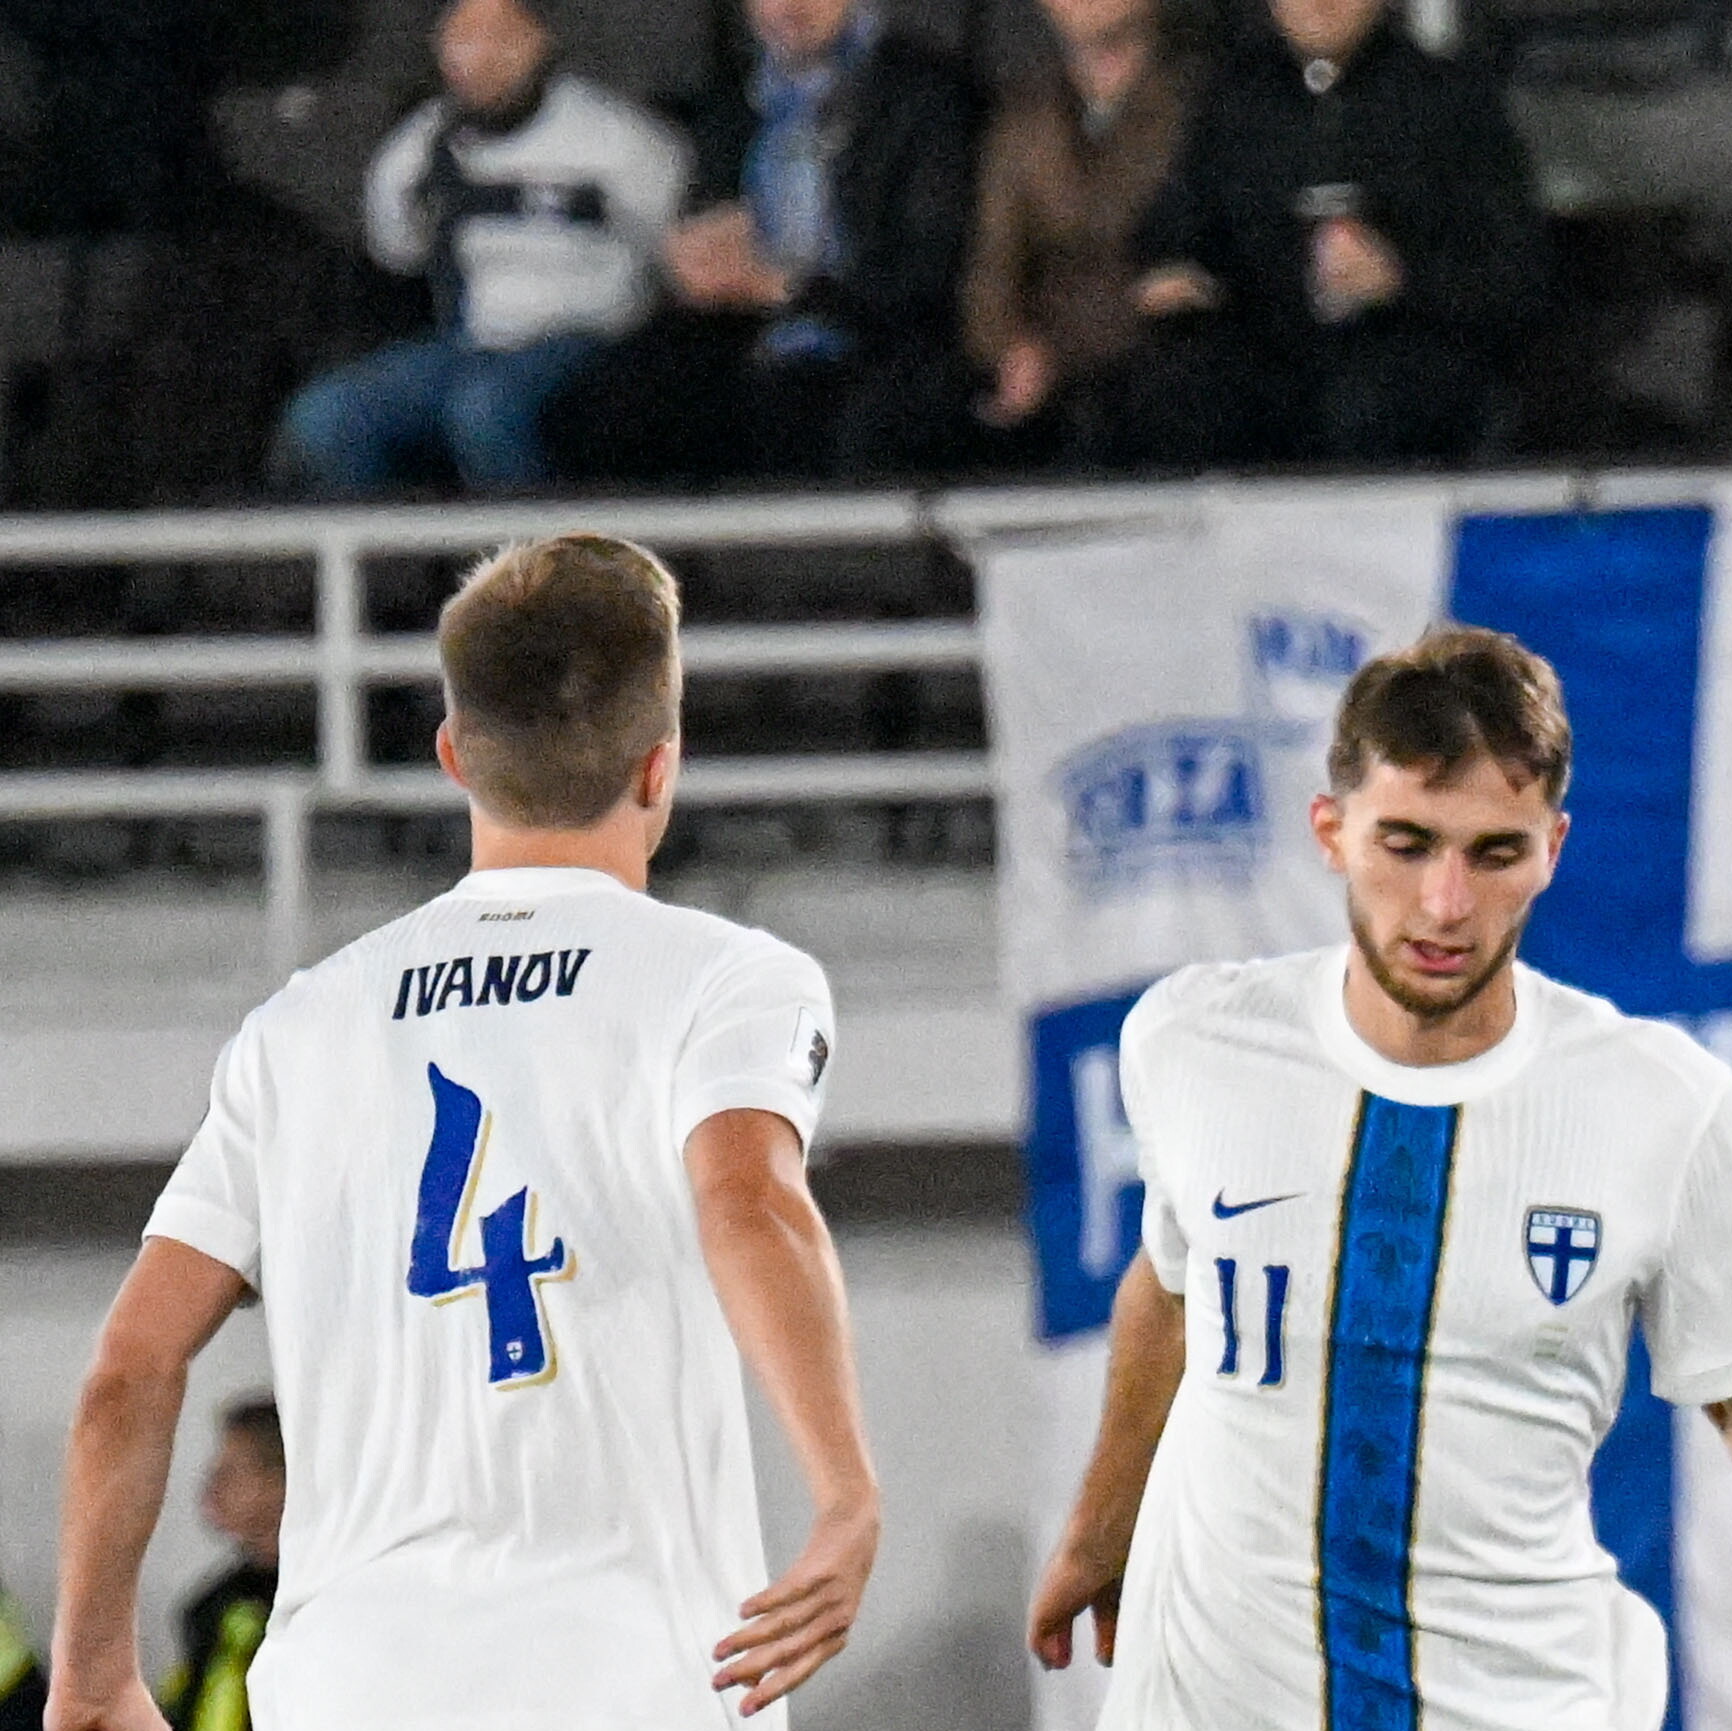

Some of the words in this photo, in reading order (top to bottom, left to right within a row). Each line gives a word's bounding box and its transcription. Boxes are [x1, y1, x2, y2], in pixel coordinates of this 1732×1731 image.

[392, 949, 592, 1021] IVANOV
[407, 1062, 577, 1391] 4
[1214, 1257, 1291, 1388] 11
